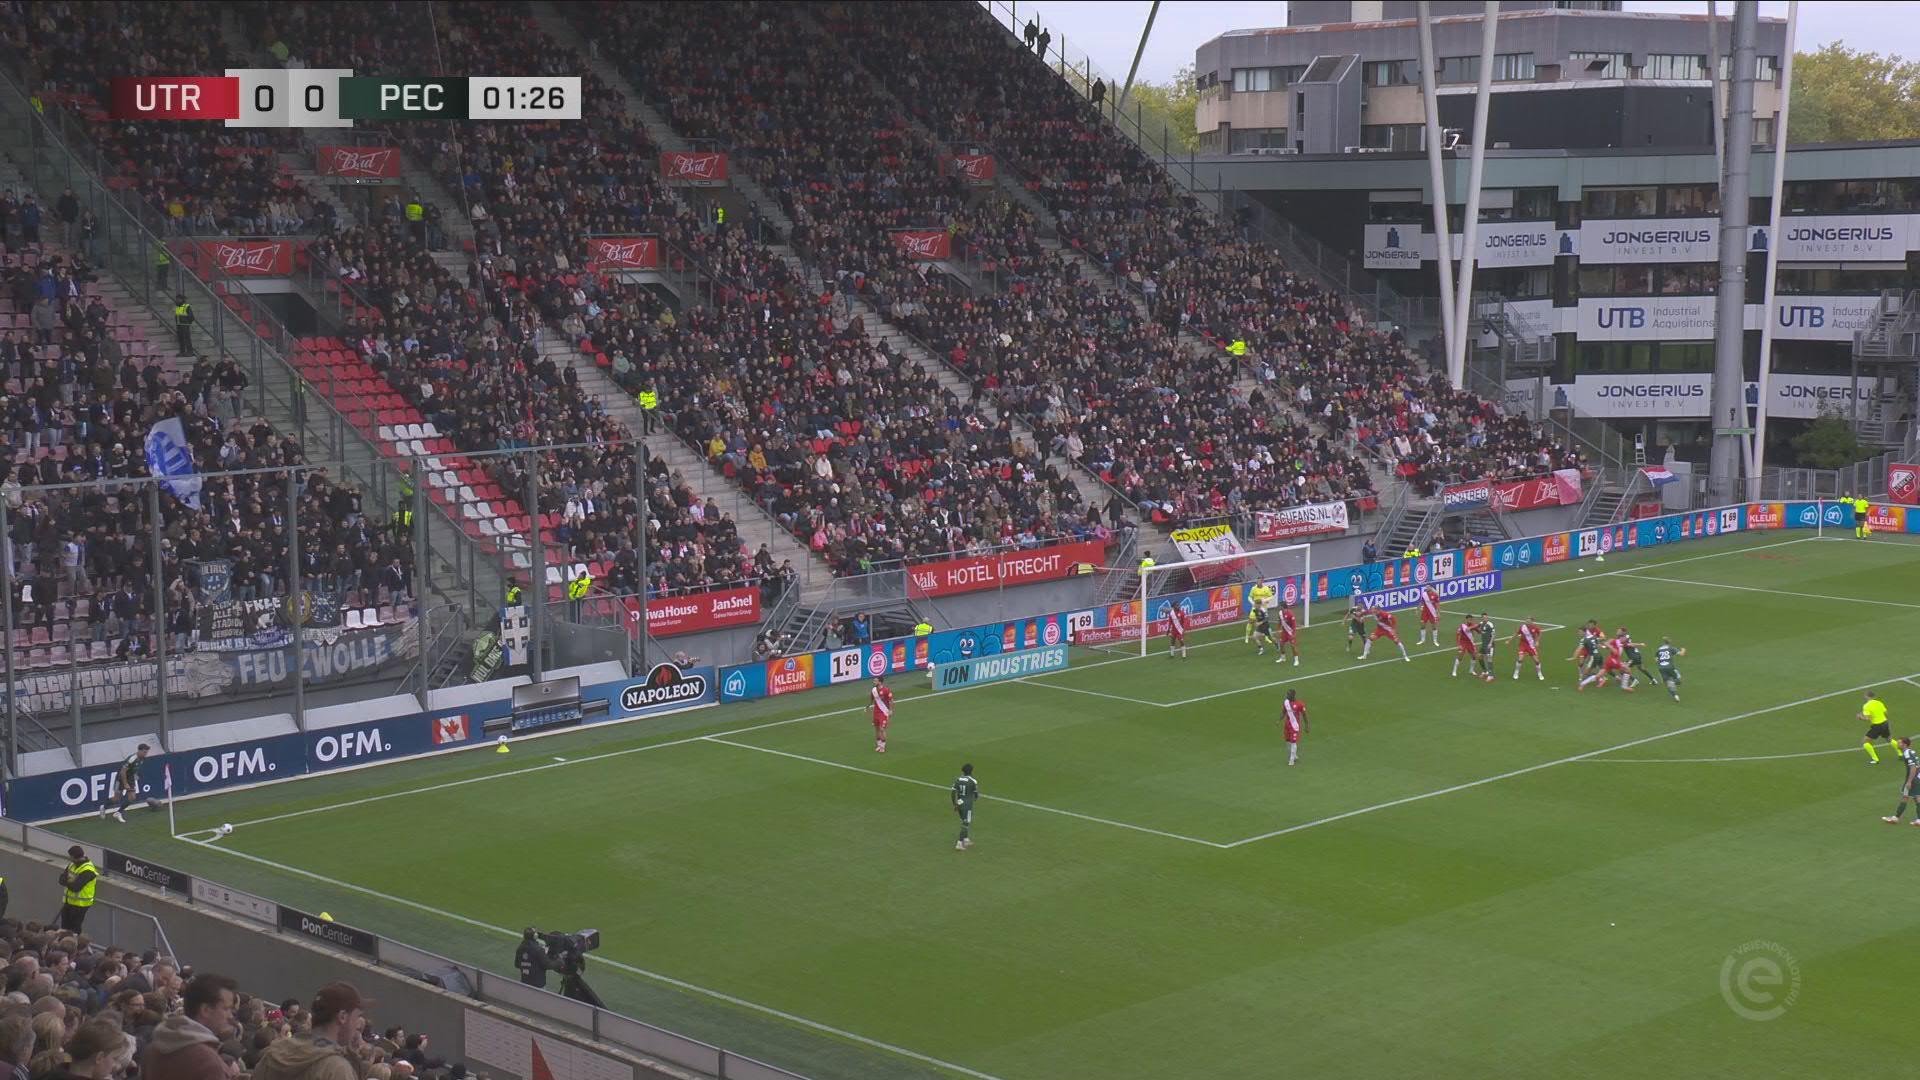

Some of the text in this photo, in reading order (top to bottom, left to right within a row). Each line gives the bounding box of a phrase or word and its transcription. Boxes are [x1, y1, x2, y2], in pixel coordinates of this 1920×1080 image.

[341, 152, 376, 169] Bud
[677, 157, 707, 175] Bud
[1485, 234, 1547, 248] JONGERIUS
[1602, 230, 1711, 244] JONGERIUS
[1787, 227, 1893, 241] JONGERIUS
[222, 248, 265, 266] Bud
[603, 244, 636, 260] Bud
[1365, 251, 1420, 259] JONGERIUS
[1598, 307, 1644, 328] UTB
[1652, 306, 1700, 316] Industrial
[1780, 306, 1825, 328] UTB
[1652, 318, 1714, 330] Acquisitions
[1832, 319, 1872, 330] Acquisit
[1597, 384, 1704, 397] JONGERIUS
[1721, 512, 1737, 529] 1.69
[1749, 513, 1778, 522] KLEUR
[1868, 516, 1898, 525] KLEUR
[1581, 534, 1596, 552] 1.69
[947, 554, 1061, 586] HOTEL UTRECHT
[1434, 556, 1452, 576] 1.69
[913, 572, 938, 588] Valk
[238, 634, 387, 685] FEU ZWOLLE
[832, 653, 859, 678] 1.69
[943, 647, 1064, 686] ION INDUSTRIES
[774, 670, 807, 685] KLEUR
[626, 681, 700, 706] NAPOLEON
[125, 859, 171, 886] PonCenter
[302, 917, 353, 945] PonCenter
